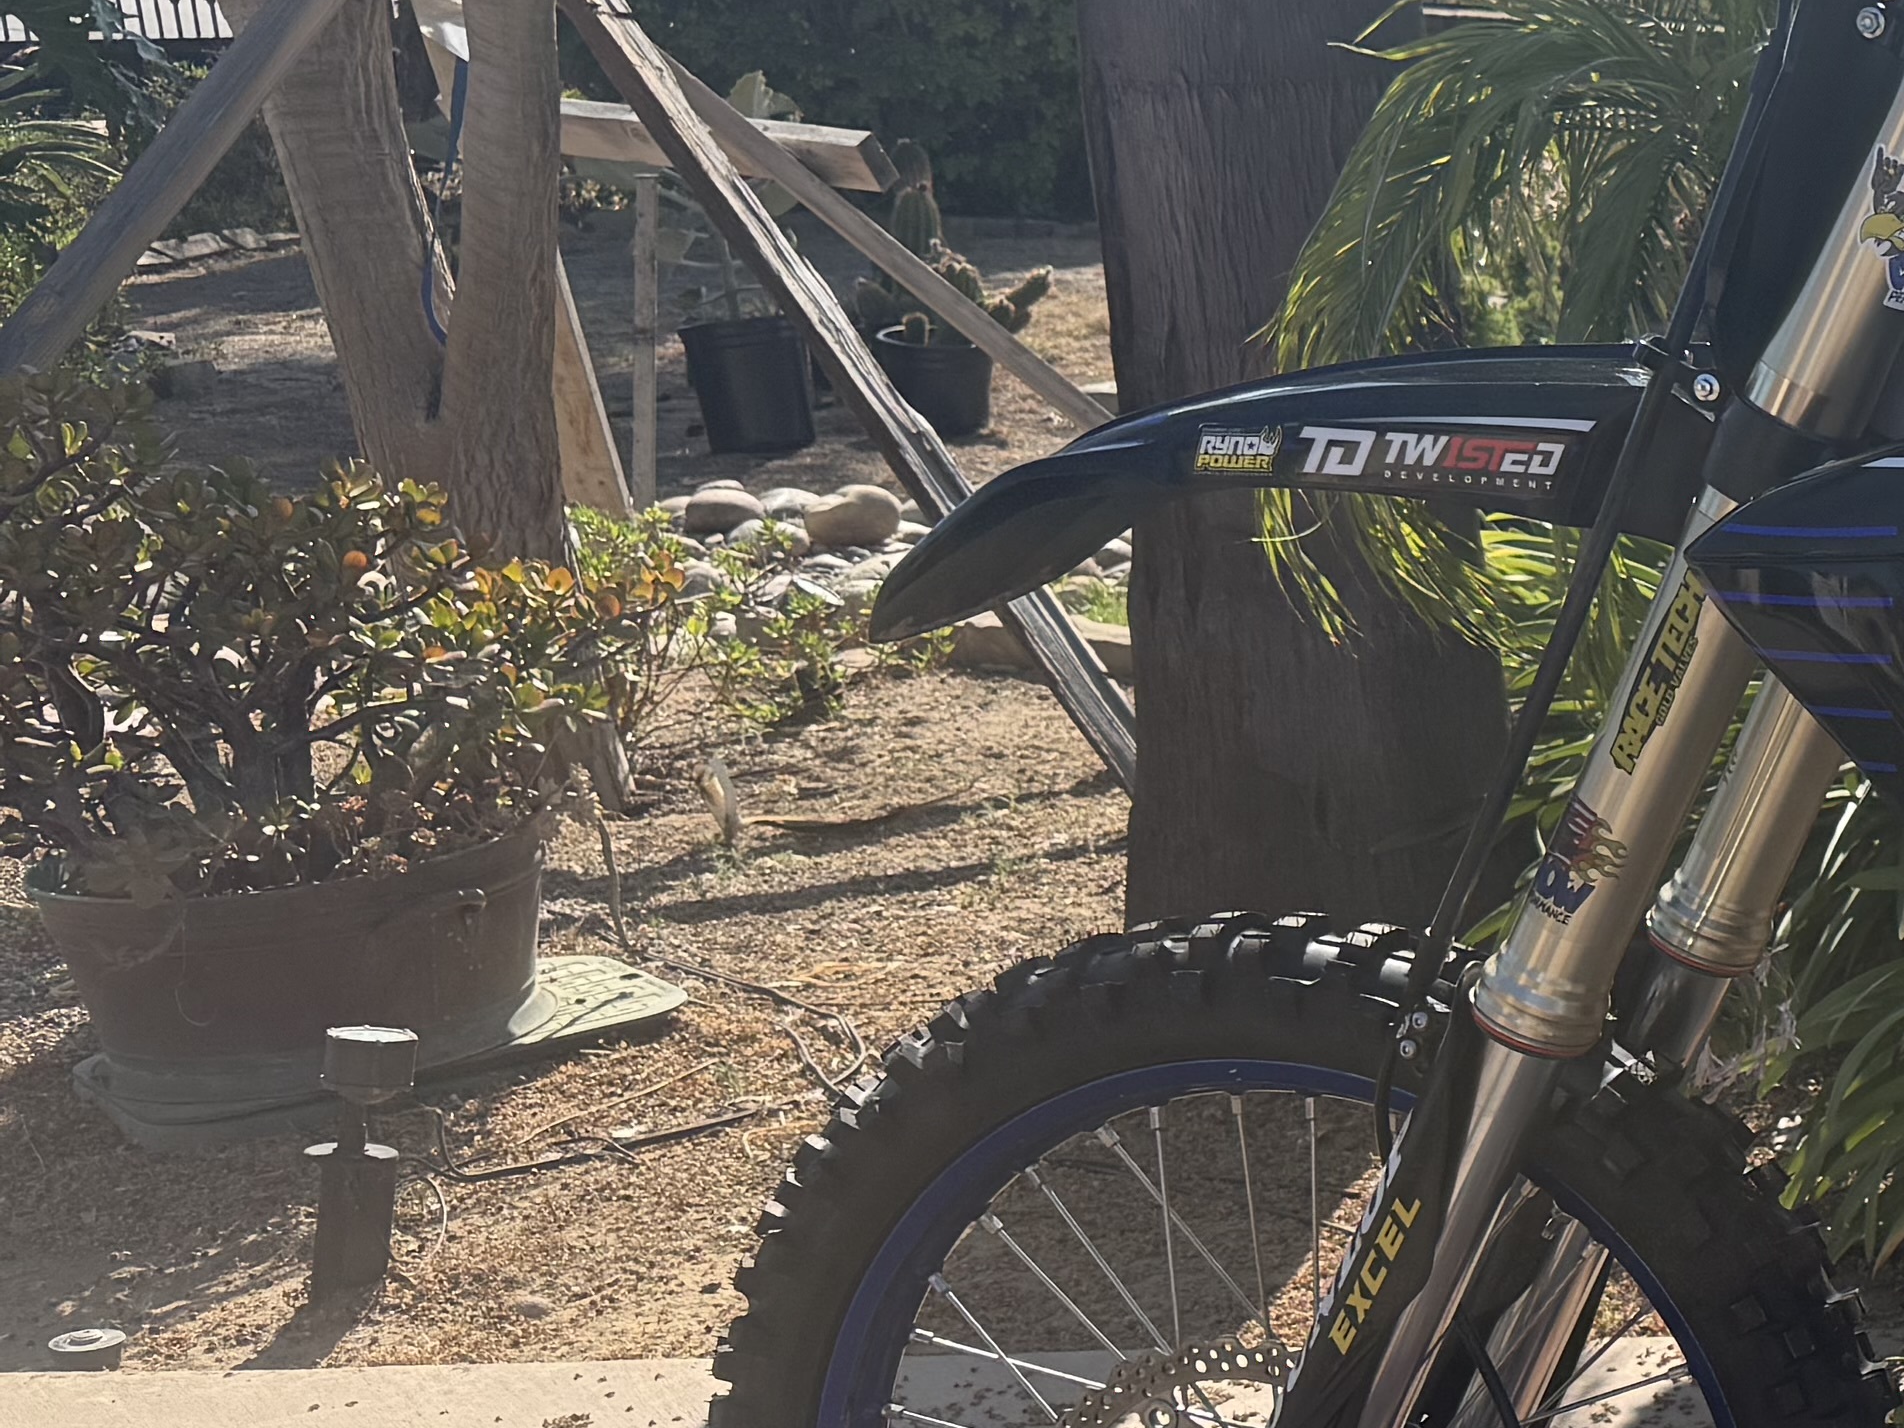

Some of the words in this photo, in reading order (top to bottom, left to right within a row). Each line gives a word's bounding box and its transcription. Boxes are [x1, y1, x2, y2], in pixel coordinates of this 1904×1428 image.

[1197, 454, 1269, 469] POWER
[1200, 435, 1260, 456] RYNO
[1300, 426, 1377, 476] TD
[1384, 469, 1554, 491] DEVELOPMENT
[1611, 666, 1667, 775] RACE
[1651, 568, 1708, 670] TECH
[1328, 1197, 1422, 1356] EXCEL
